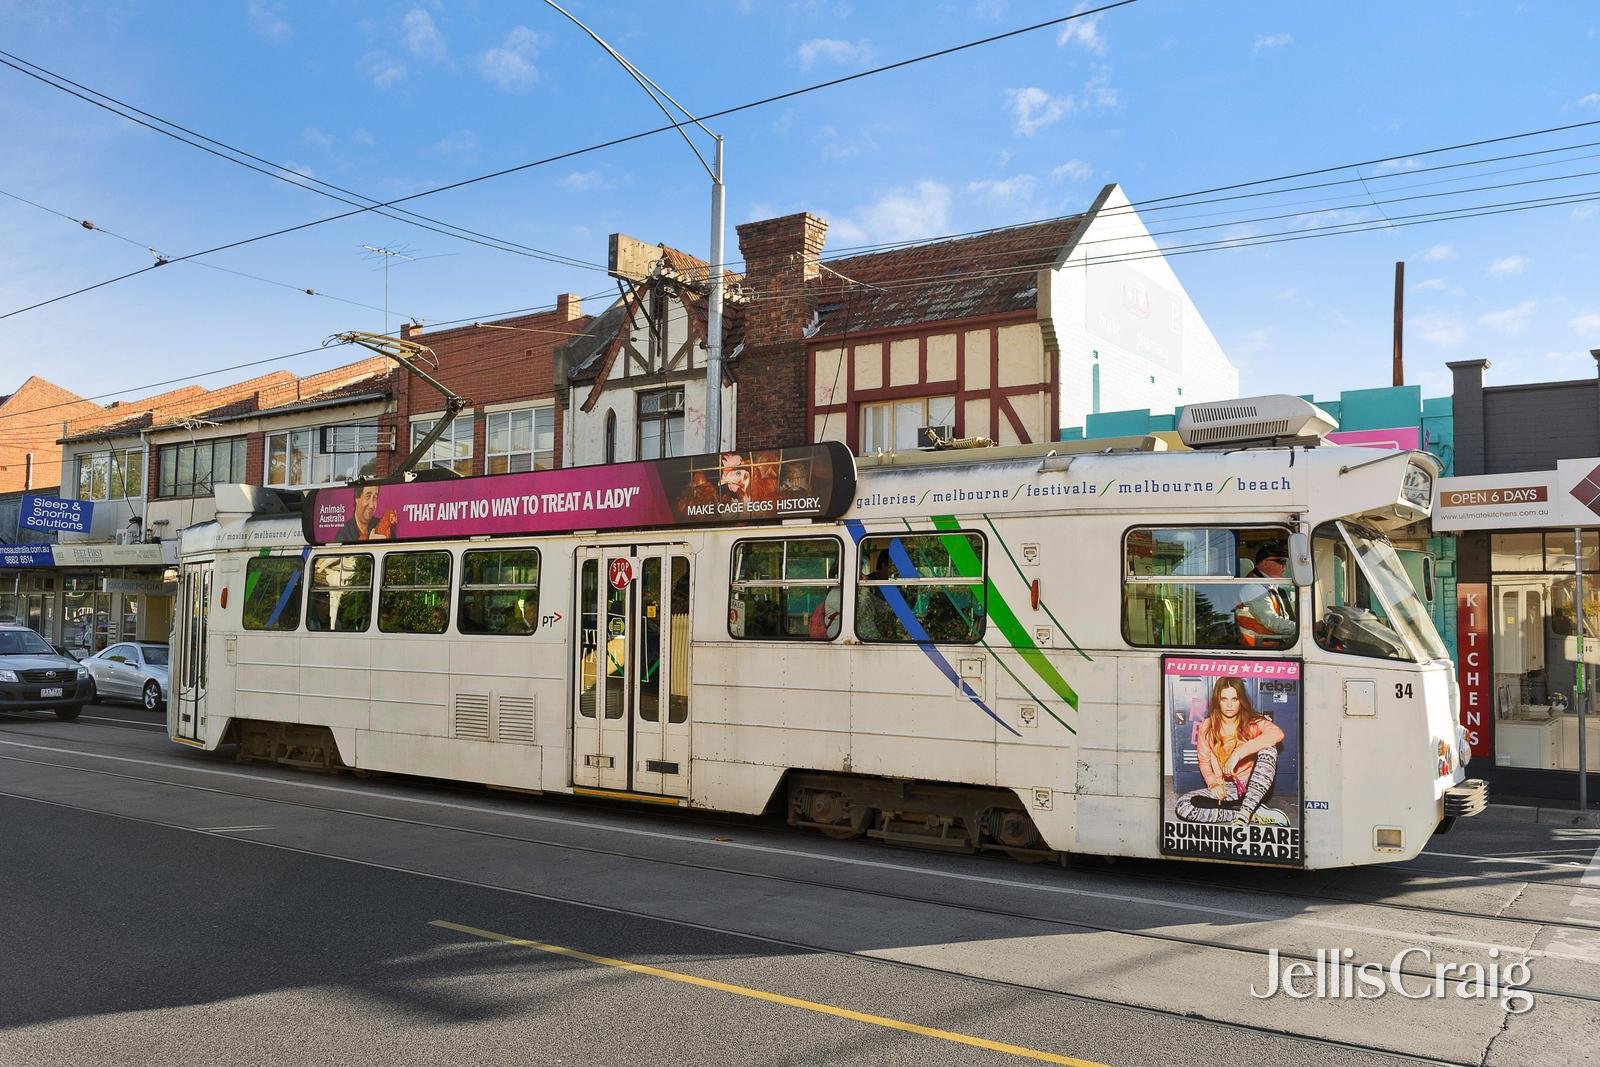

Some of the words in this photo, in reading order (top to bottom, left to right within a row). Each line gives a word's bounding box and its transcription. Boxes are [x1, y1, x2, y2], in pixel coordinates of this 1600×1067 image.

[856, 494, 916, 509] galleries
[933, 489, 1009, 502] melbourne
[1027, 482, 1096, 496] festivals
[1118, 480, 1213, 493] melbourne
[1237, 477, 1291, 490] beach
[1450, 492, 1487, 505] OPEN
[1491, 491, 1500, 502] 6
[1504, 489, 1537, 502] DAYS
[33, 497, 69, 511] Sleep
[72, 501, 82, 511] &
[320, 503, 345, 514] Animals
[437, 501, 468, 520] AIN'T
[470, 499, 489, 518] NO
[492, 496, 520, 517] WAY
[521, 494, 539, 515] TO
[541, 491, 581, 513] TREAT
[583, 490, 593, 511] A
[687, 504, 715, 515] MAKE
[717, 502, 744, 514] CAGE
[747, 500, 773, 512] EGGS
[777, 497, 821, 511] HISTORY.
[33, 507, 80, 522] Snoring
[319, 513, 345, 523] Australia
[26, 516, 83, 530] Solutions
[254, 529, 287, 539] melbourne
[613, 562, 630, 572] STOP
[1166, 661, 1239, 675] running
[1253, 663, 1297, 674] bare
[1466, 593, 1481, 746] KITCHENS
[1259, 680, 1297, 692] rebel
[1395, 683, 1413, 699] 34
[1305, 801, 1328, 810] APN
[1164, 822, 1248, 843] RUNNING
[1250, 827, 1300, 846] BARE
